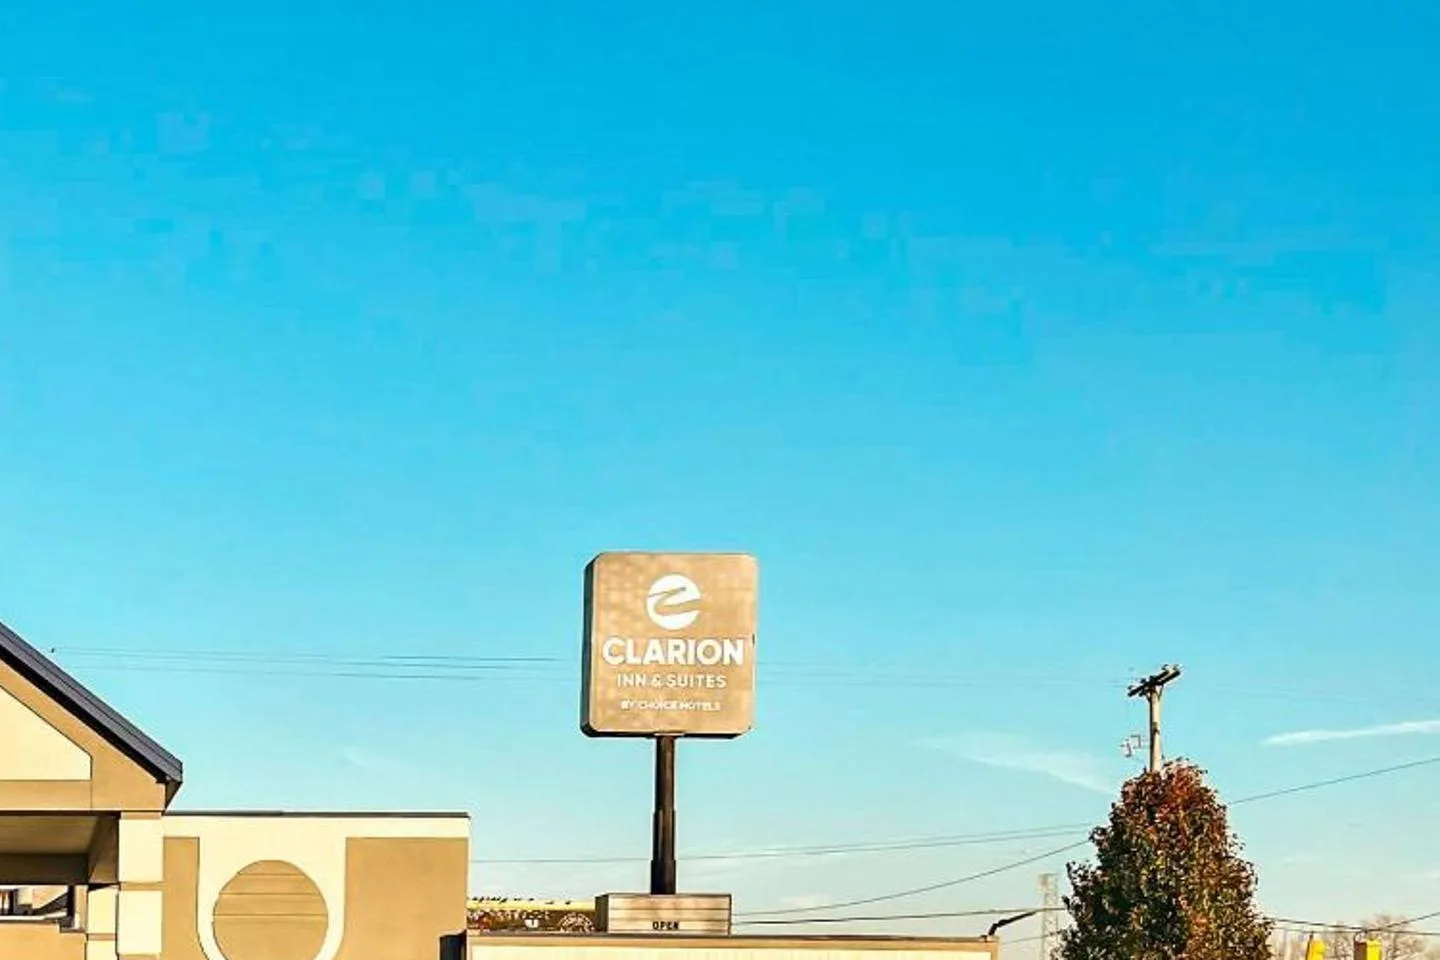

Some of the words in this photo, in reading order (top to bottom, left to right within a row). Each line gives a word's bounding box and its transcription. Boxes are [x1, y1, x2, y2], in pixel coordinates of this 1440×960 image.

[602, 636, 744, 666] CLARION
[617, 673, 646, 688] INN
[651, 674, 662, 688] &
[666, 673, 727, 689] SUITES
[620, 700, 635, 711] BY
[639, 700, 677, 711] CHOICE
[679, 700, 721, 712] HOTELS
[652, 920, 679, 930] OPEN
